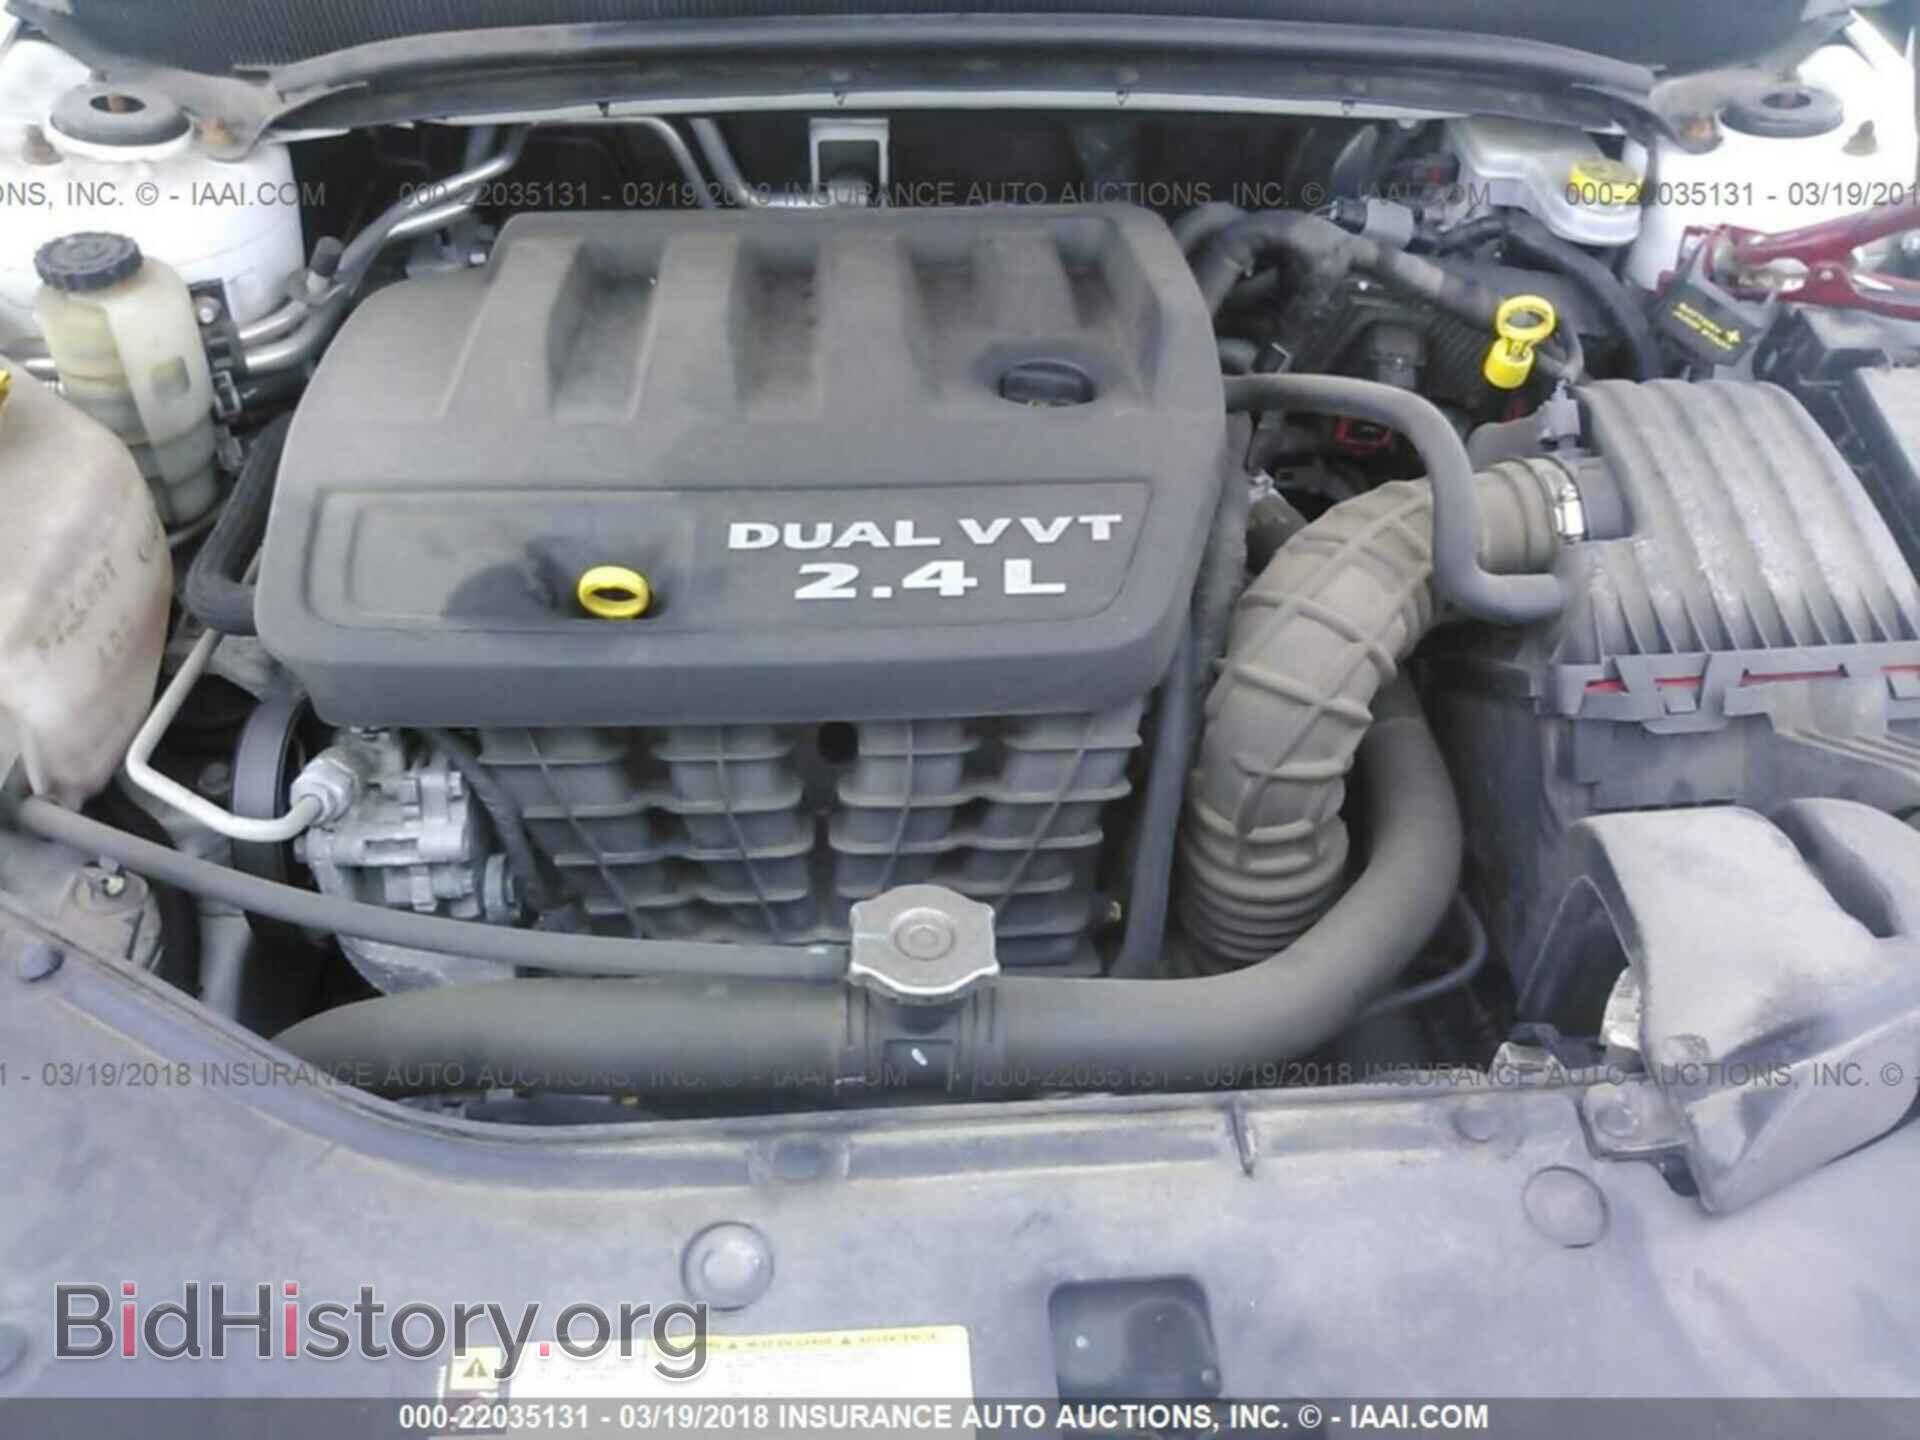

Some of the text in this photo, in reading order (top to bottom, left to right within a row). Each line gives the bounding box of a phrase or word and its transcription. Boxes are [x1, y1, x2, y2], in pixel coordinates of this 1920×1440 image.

[728, 514, 1122, 549] DUAL VVT
[794, 558, 1066, 600] 2.4 L
